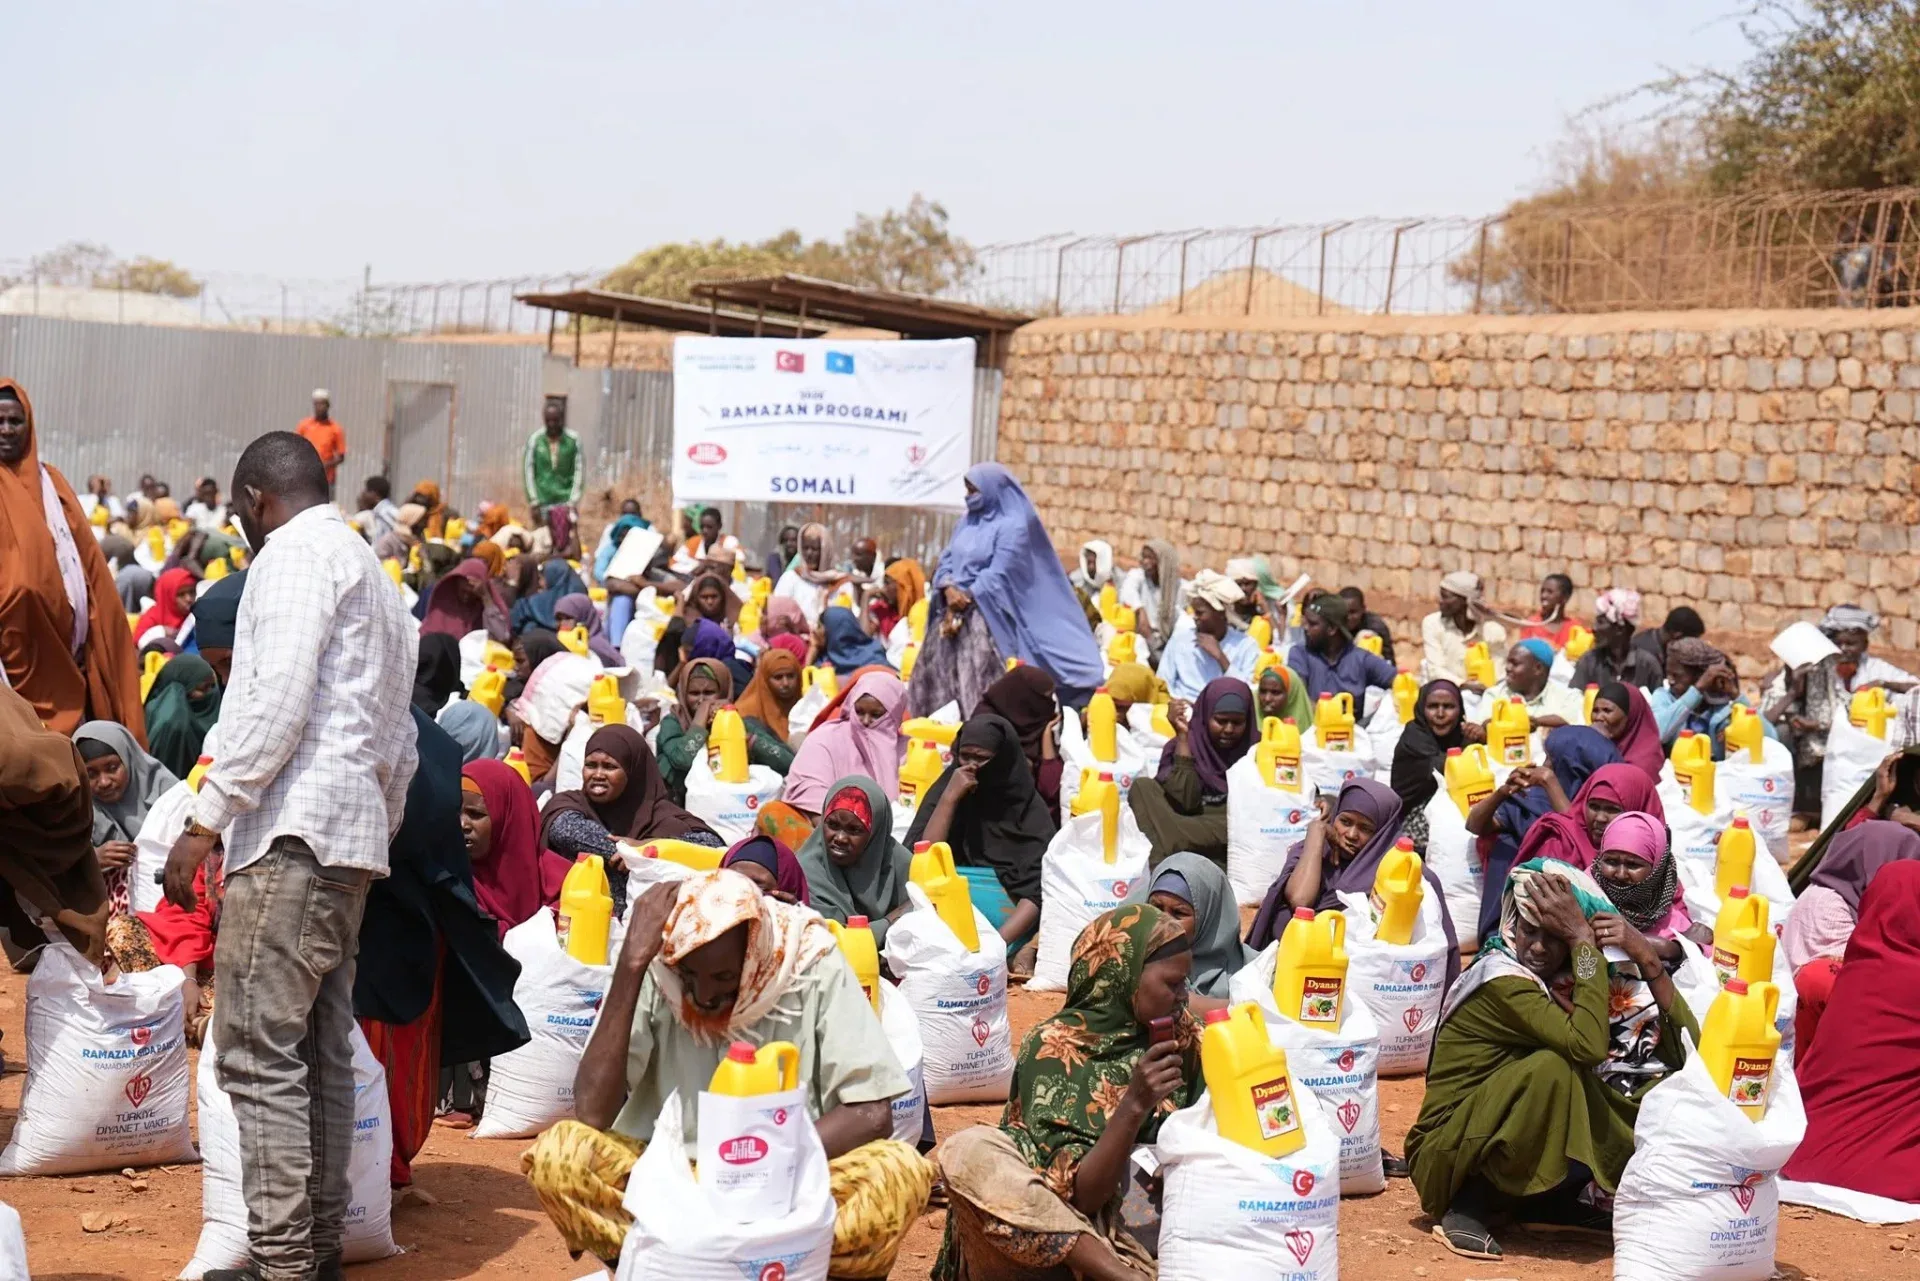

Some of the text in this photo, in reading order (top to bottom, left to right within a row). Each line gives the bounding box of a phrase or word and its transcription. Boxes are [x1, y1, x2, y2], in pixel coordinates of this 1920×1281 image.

[721, 403, 907, 422] RAMAZAN PROGRAMI
[770, 474, 855, 494] SOMALİ
[1307, 979, 1338, 990] Dyanas
[1373, 984, 1412, 992] RAMAZAN
[937, 999, 979, 1009] RAMAZAN
[82, 1048, 136, 1060] RAMAZAN
[1738, 1061, 1769, 1072] Dyanas
[1345, 1073, 1363, 1084] GIDA
[1254, 1082, 1287, 1099] Dyanas
[144, 1117, 169, 1130] VAKFI
[1239, 1200, 1296, 1211] RAMAZAN
[1298, 1200, 1317, 1211] GIDA
